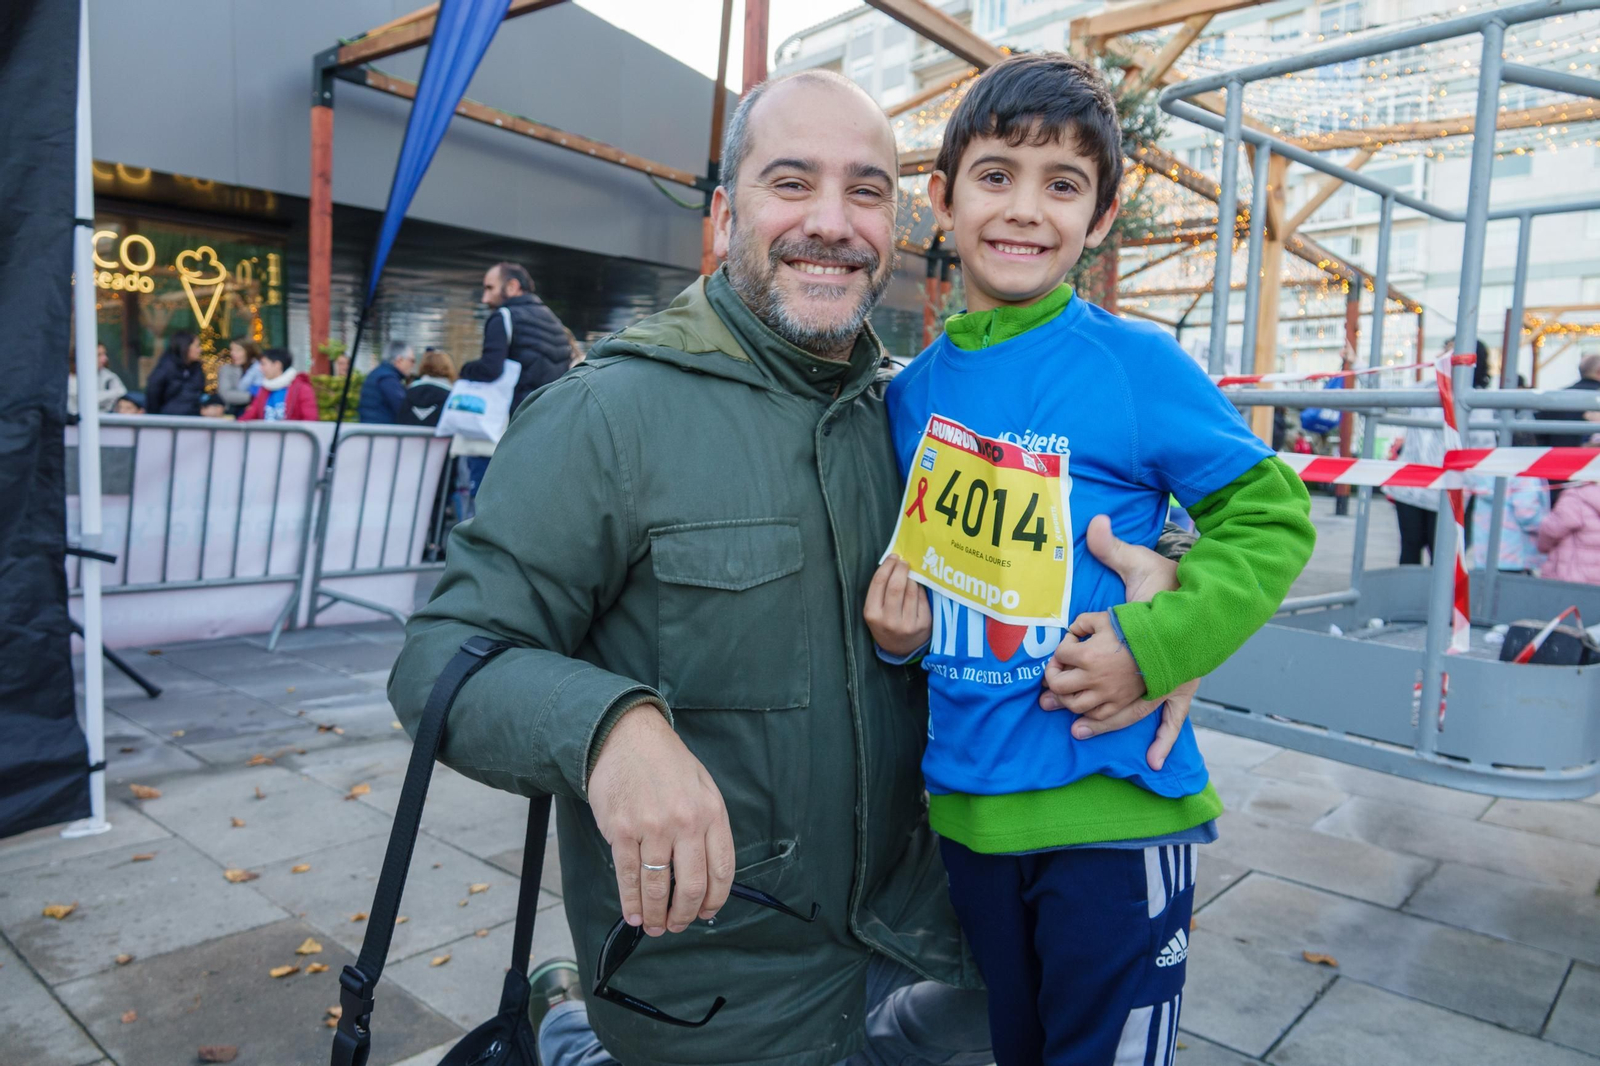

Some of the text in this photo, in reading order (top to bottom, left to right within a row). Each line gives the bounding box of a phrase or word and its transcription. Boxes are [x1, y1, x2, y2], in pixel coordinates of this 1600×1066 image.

[934, 469, 1048, 552] 4014
[950, 539, 1012, 568] Pablo GAREA LOURES
[921, 545, 1020, 610] Alcampo
[962, 666, 1013, 685] mesma
